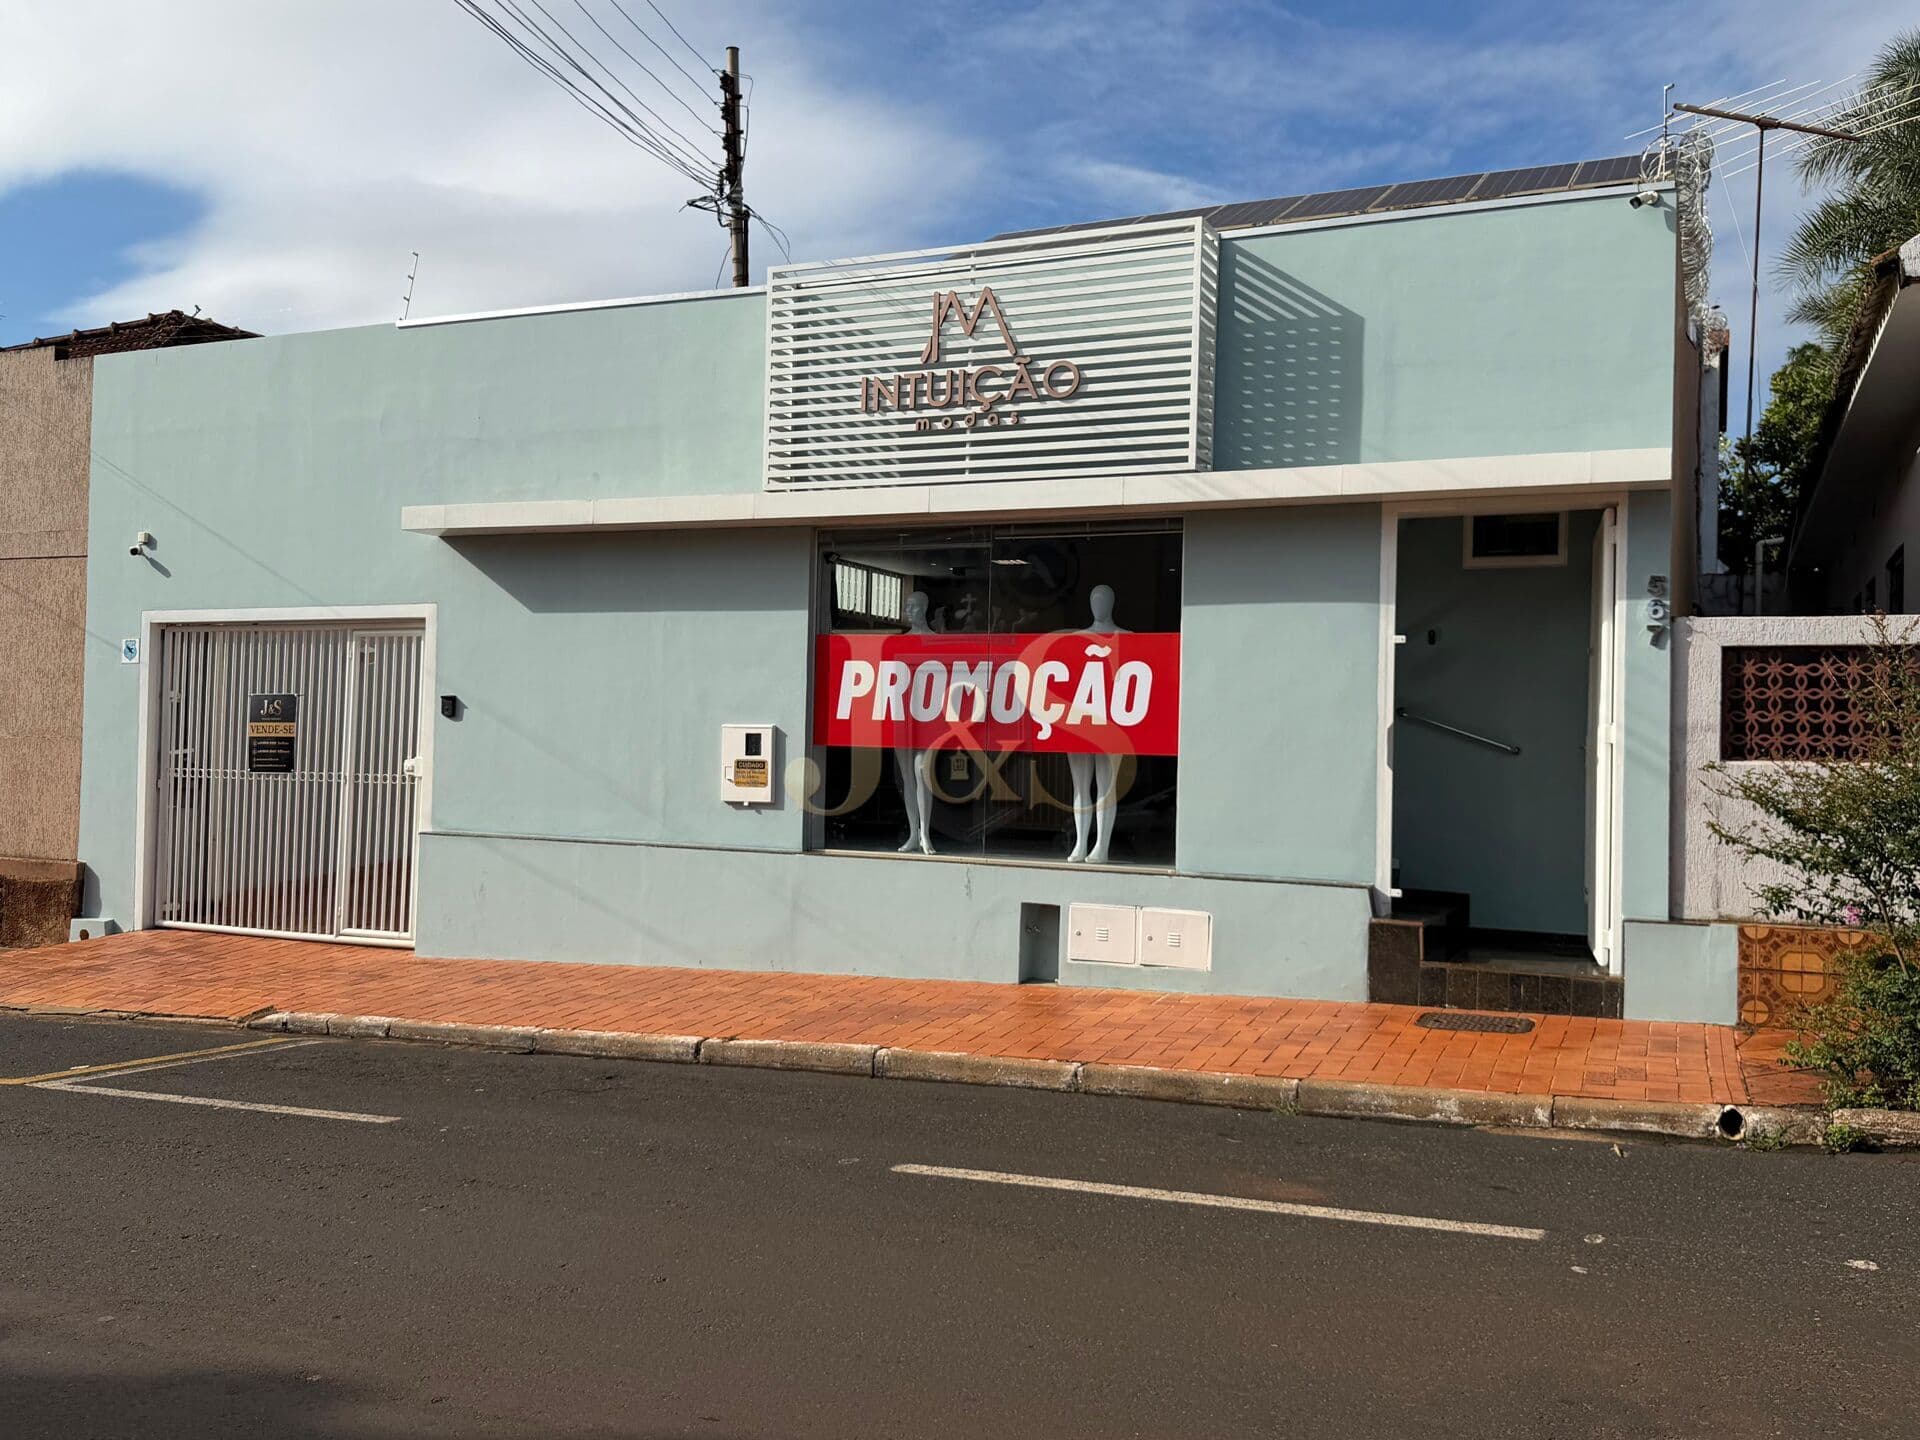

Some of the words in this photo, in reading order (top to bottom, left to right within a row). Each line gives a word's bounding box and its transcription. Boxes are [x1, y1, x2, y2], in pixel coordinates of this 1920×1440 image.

[861, 354, 1081, 413] INTUIÇÃO
[915, 411, 1020, 432] modas
[836, 643, 1154, 740] PROMOÇÃO
[260, 699, 282, 716] J&S
[250, 724, 295, 735] VENDE-SE
[738, 761, 764, 769] CUIDADO
